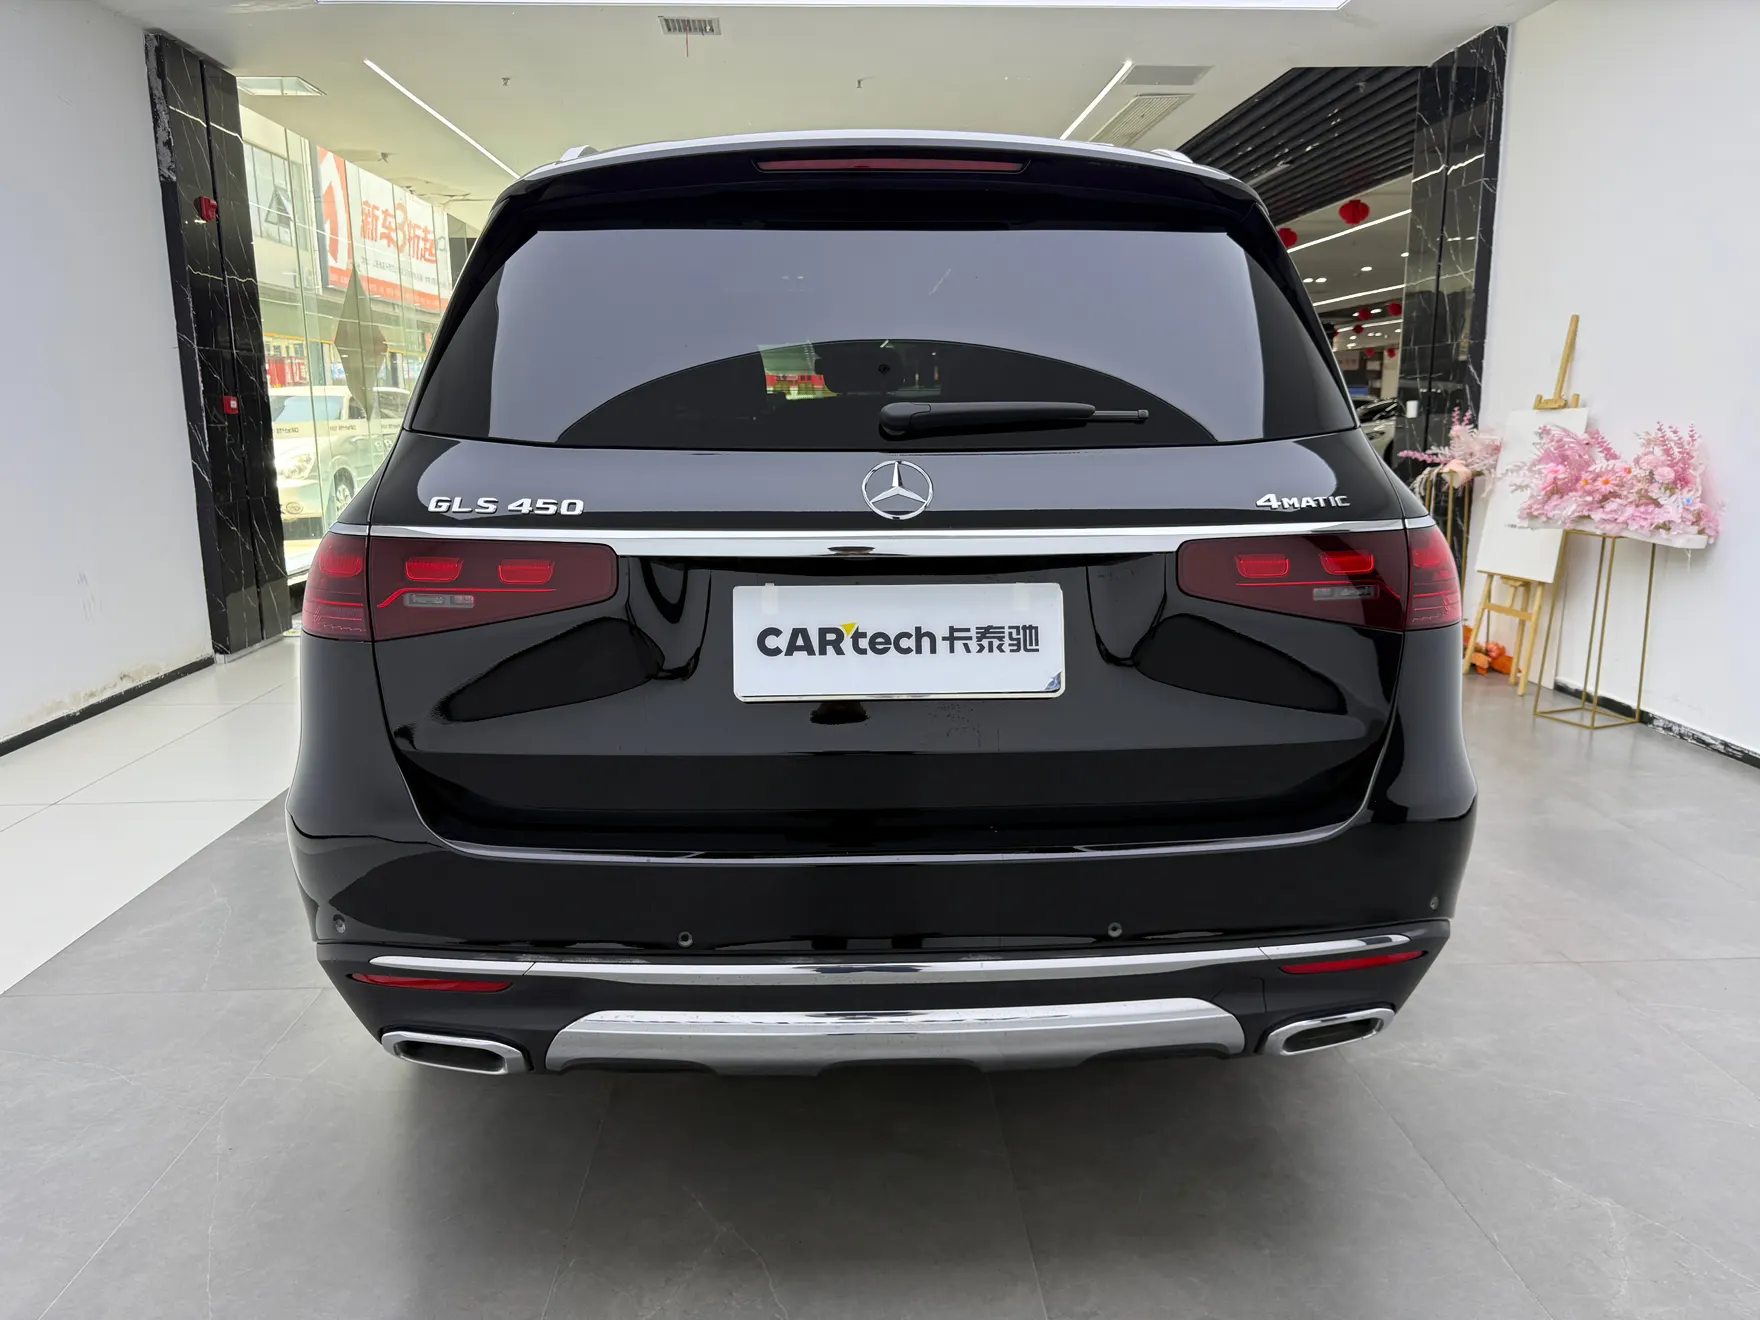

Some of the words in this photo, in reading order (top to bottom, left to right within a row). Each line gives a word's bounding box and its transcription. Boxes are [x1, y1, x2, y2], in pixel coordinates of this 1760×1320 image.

[427, 496, 499, 514] GLS
[507, 498, 585, 516] 450
[1256, 493, 1351, 509] 4MATIC
[941, 624, 1040, 654] 卡泰驰
